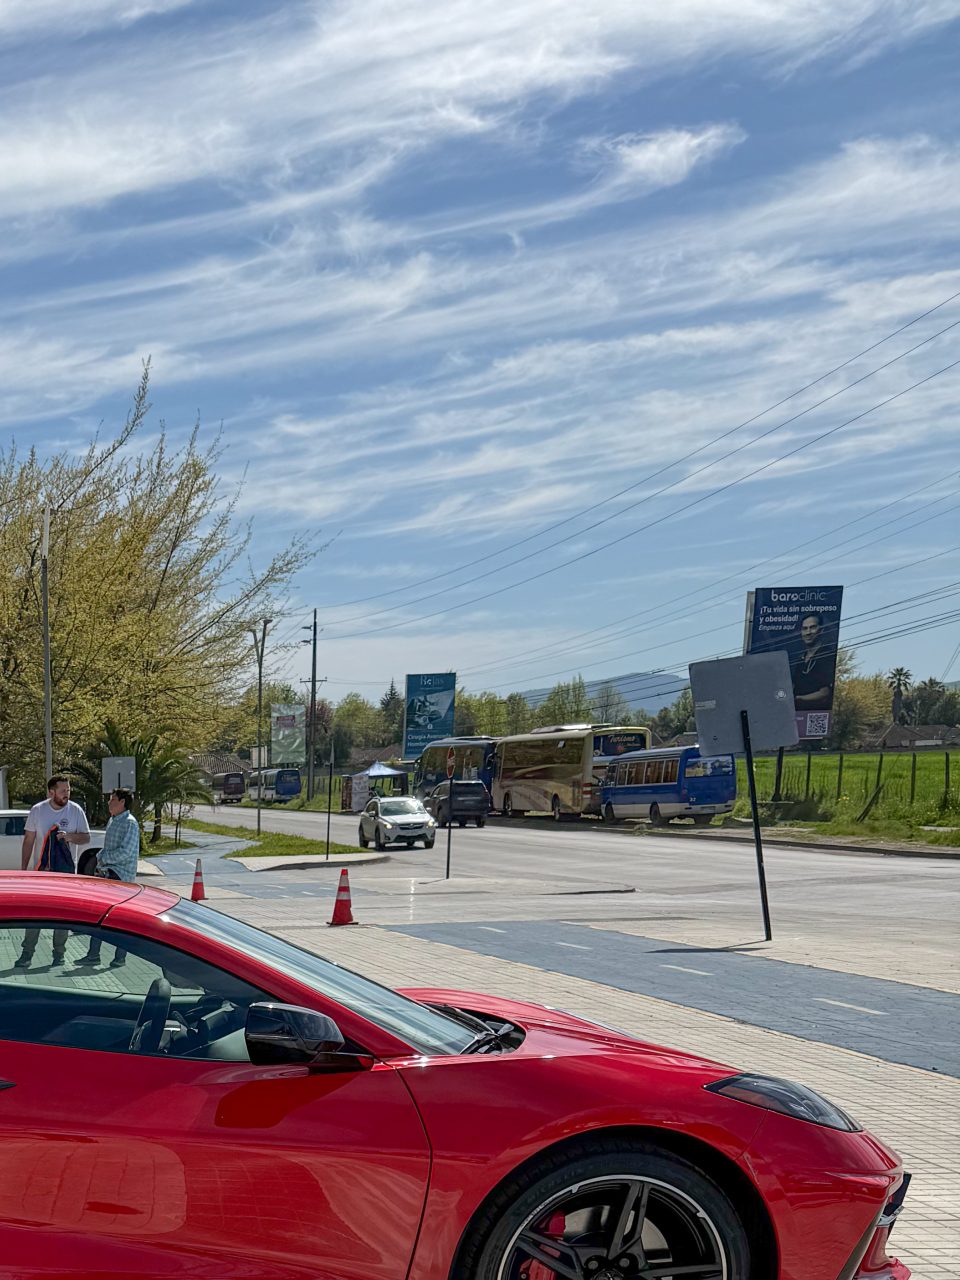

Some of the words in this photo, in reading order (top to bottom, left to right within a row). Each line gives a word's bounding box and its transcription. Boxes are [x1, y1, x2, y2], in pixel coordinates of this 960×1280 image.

[771, 589, 826, 602] baroclinic
[760, 606, 772, 614] ¡Tu
[801, 604, 837, 613] sobrepeso
[759, 616, 764, 624] y
[765, 614, 799, 622] obesidad!
